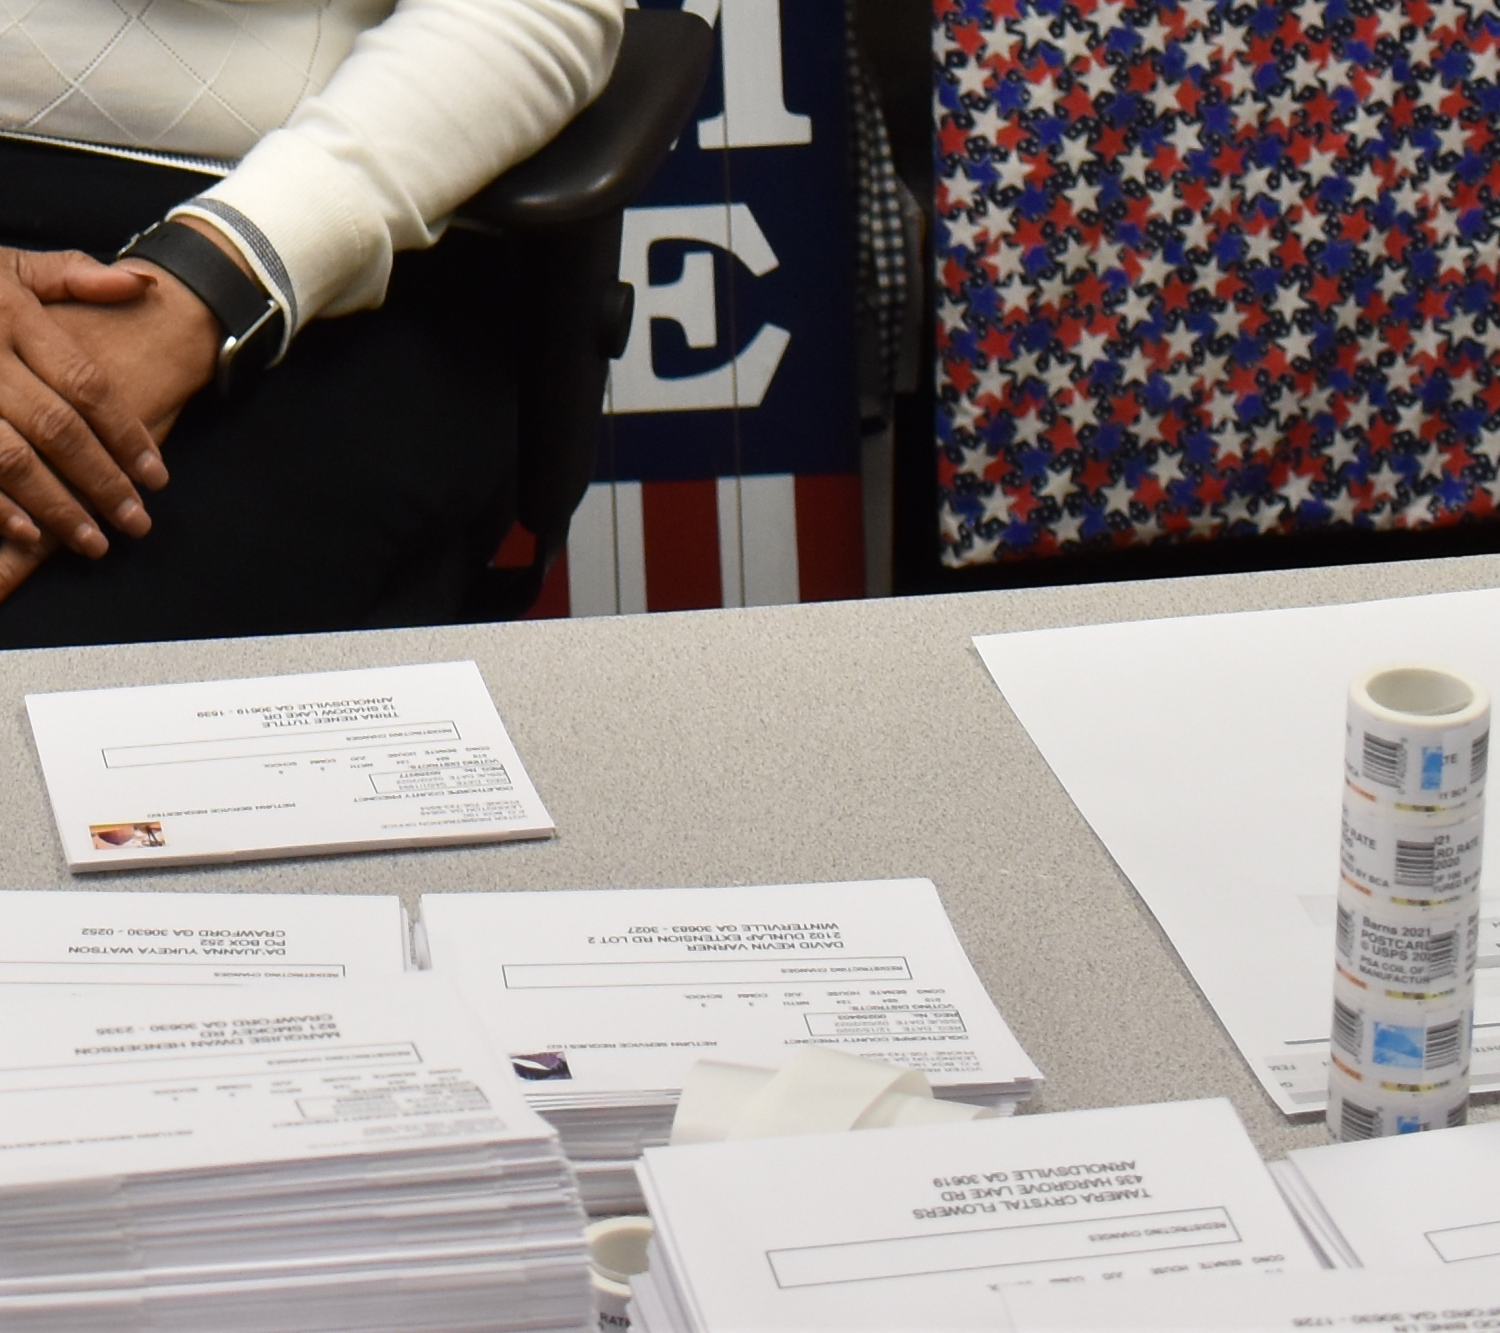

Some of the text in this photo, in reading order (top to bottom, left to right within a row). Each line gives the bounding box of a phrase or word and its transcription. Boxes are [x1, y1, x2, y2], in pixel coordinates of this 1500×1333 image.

[275, 696, 393, 713] ARNOLDSVILLE GA
[261, 711, 398, 729] TRINA RENEE TUTTLE
[262, 703, 395, 723] 12 SHADOW LAKE DR
[1350, 827, 1377, 851] RATE
[172, 929, 287, 938] CRAWFORD GA
[627, 922, 840, 934] WINTERVILLE GA 3027
[1362, 915, 1432, 938] Barns 2021
[199, 938, 286, 947] PO BOX 252
[587, 931, 840, 945] 2102 DUNLAP EXTENSION RD LOT 2
[67, 945, 287, 956] DA'JUANNA YUKEYA WATSON
[686, 941, 844, 953] DAVID KEVIN VARNER
[1371, 945, 1408, 961] USPS
[203, 1014, 334, 1029] CRAWFORD GA
[199, 1024, 303, 1039] SMOKEY RD
[74, 1032, 341, 1056] MARQUISE DWAN HENDERSON
[932, 1160, 1136, 1189] ARNOLDSVILLE GA 30619
[940, 1174, 1143, 1203] 435 HARGROVE LAKE RD
[912, 1187, 1151, 1220] TAMERA CRYSTAL FLOWERS
